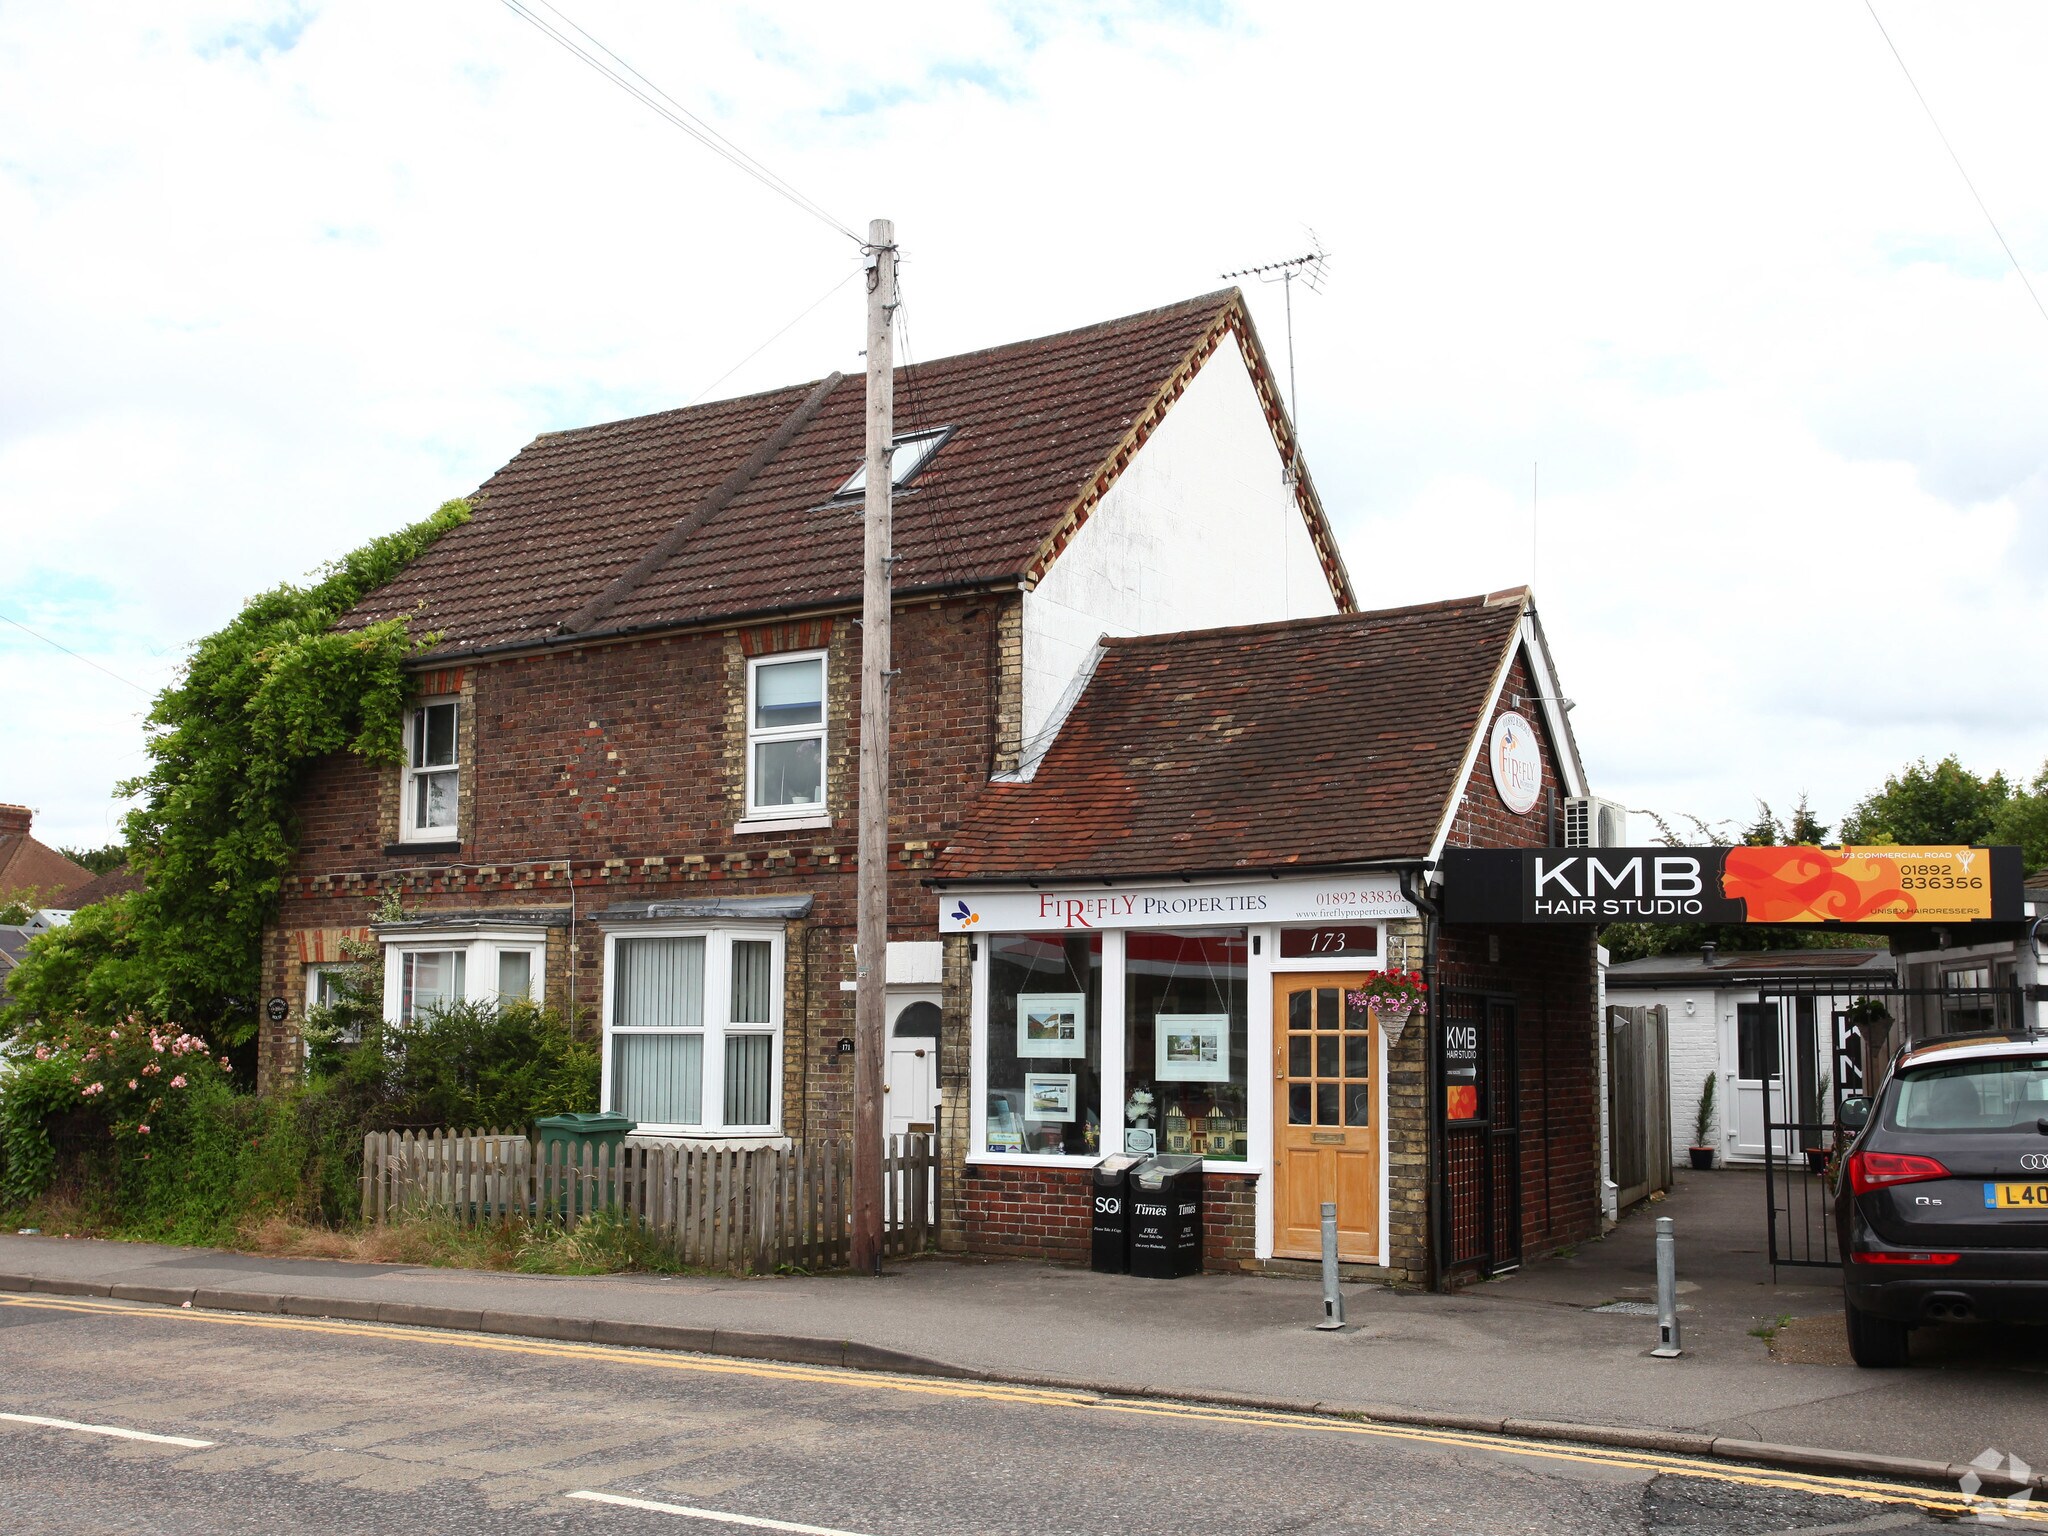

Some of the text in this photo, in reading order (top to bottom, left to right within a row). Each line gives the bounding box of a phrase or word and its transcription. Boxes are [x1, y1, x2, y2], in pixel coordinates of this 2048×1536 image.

[1900, 865, 1952, 875] 01892
[1535, 857, 1703, 897] KMB
[1901, 877, 1983, 889] 836356
[1143, 895, 1267, 914] PROPERTIES
[1316, 891, 1356, 906] 01892
[1295, 905, 1411, 918] www.fireflyproperties.co.uk
[1535, 899, 1703, 915] HAIR STUDIO
[1310, 933, 1346, 951] 173
[1446, 1026, 1477, 1049] KMB
[1446, 1050, 1477, 1059] HAIR STUDIO
[1915, 1196, 1942, 1206] Q5
[1134, 1203, 1167, 1216] Times
[1178, 1204, 1196, 1215] Times
